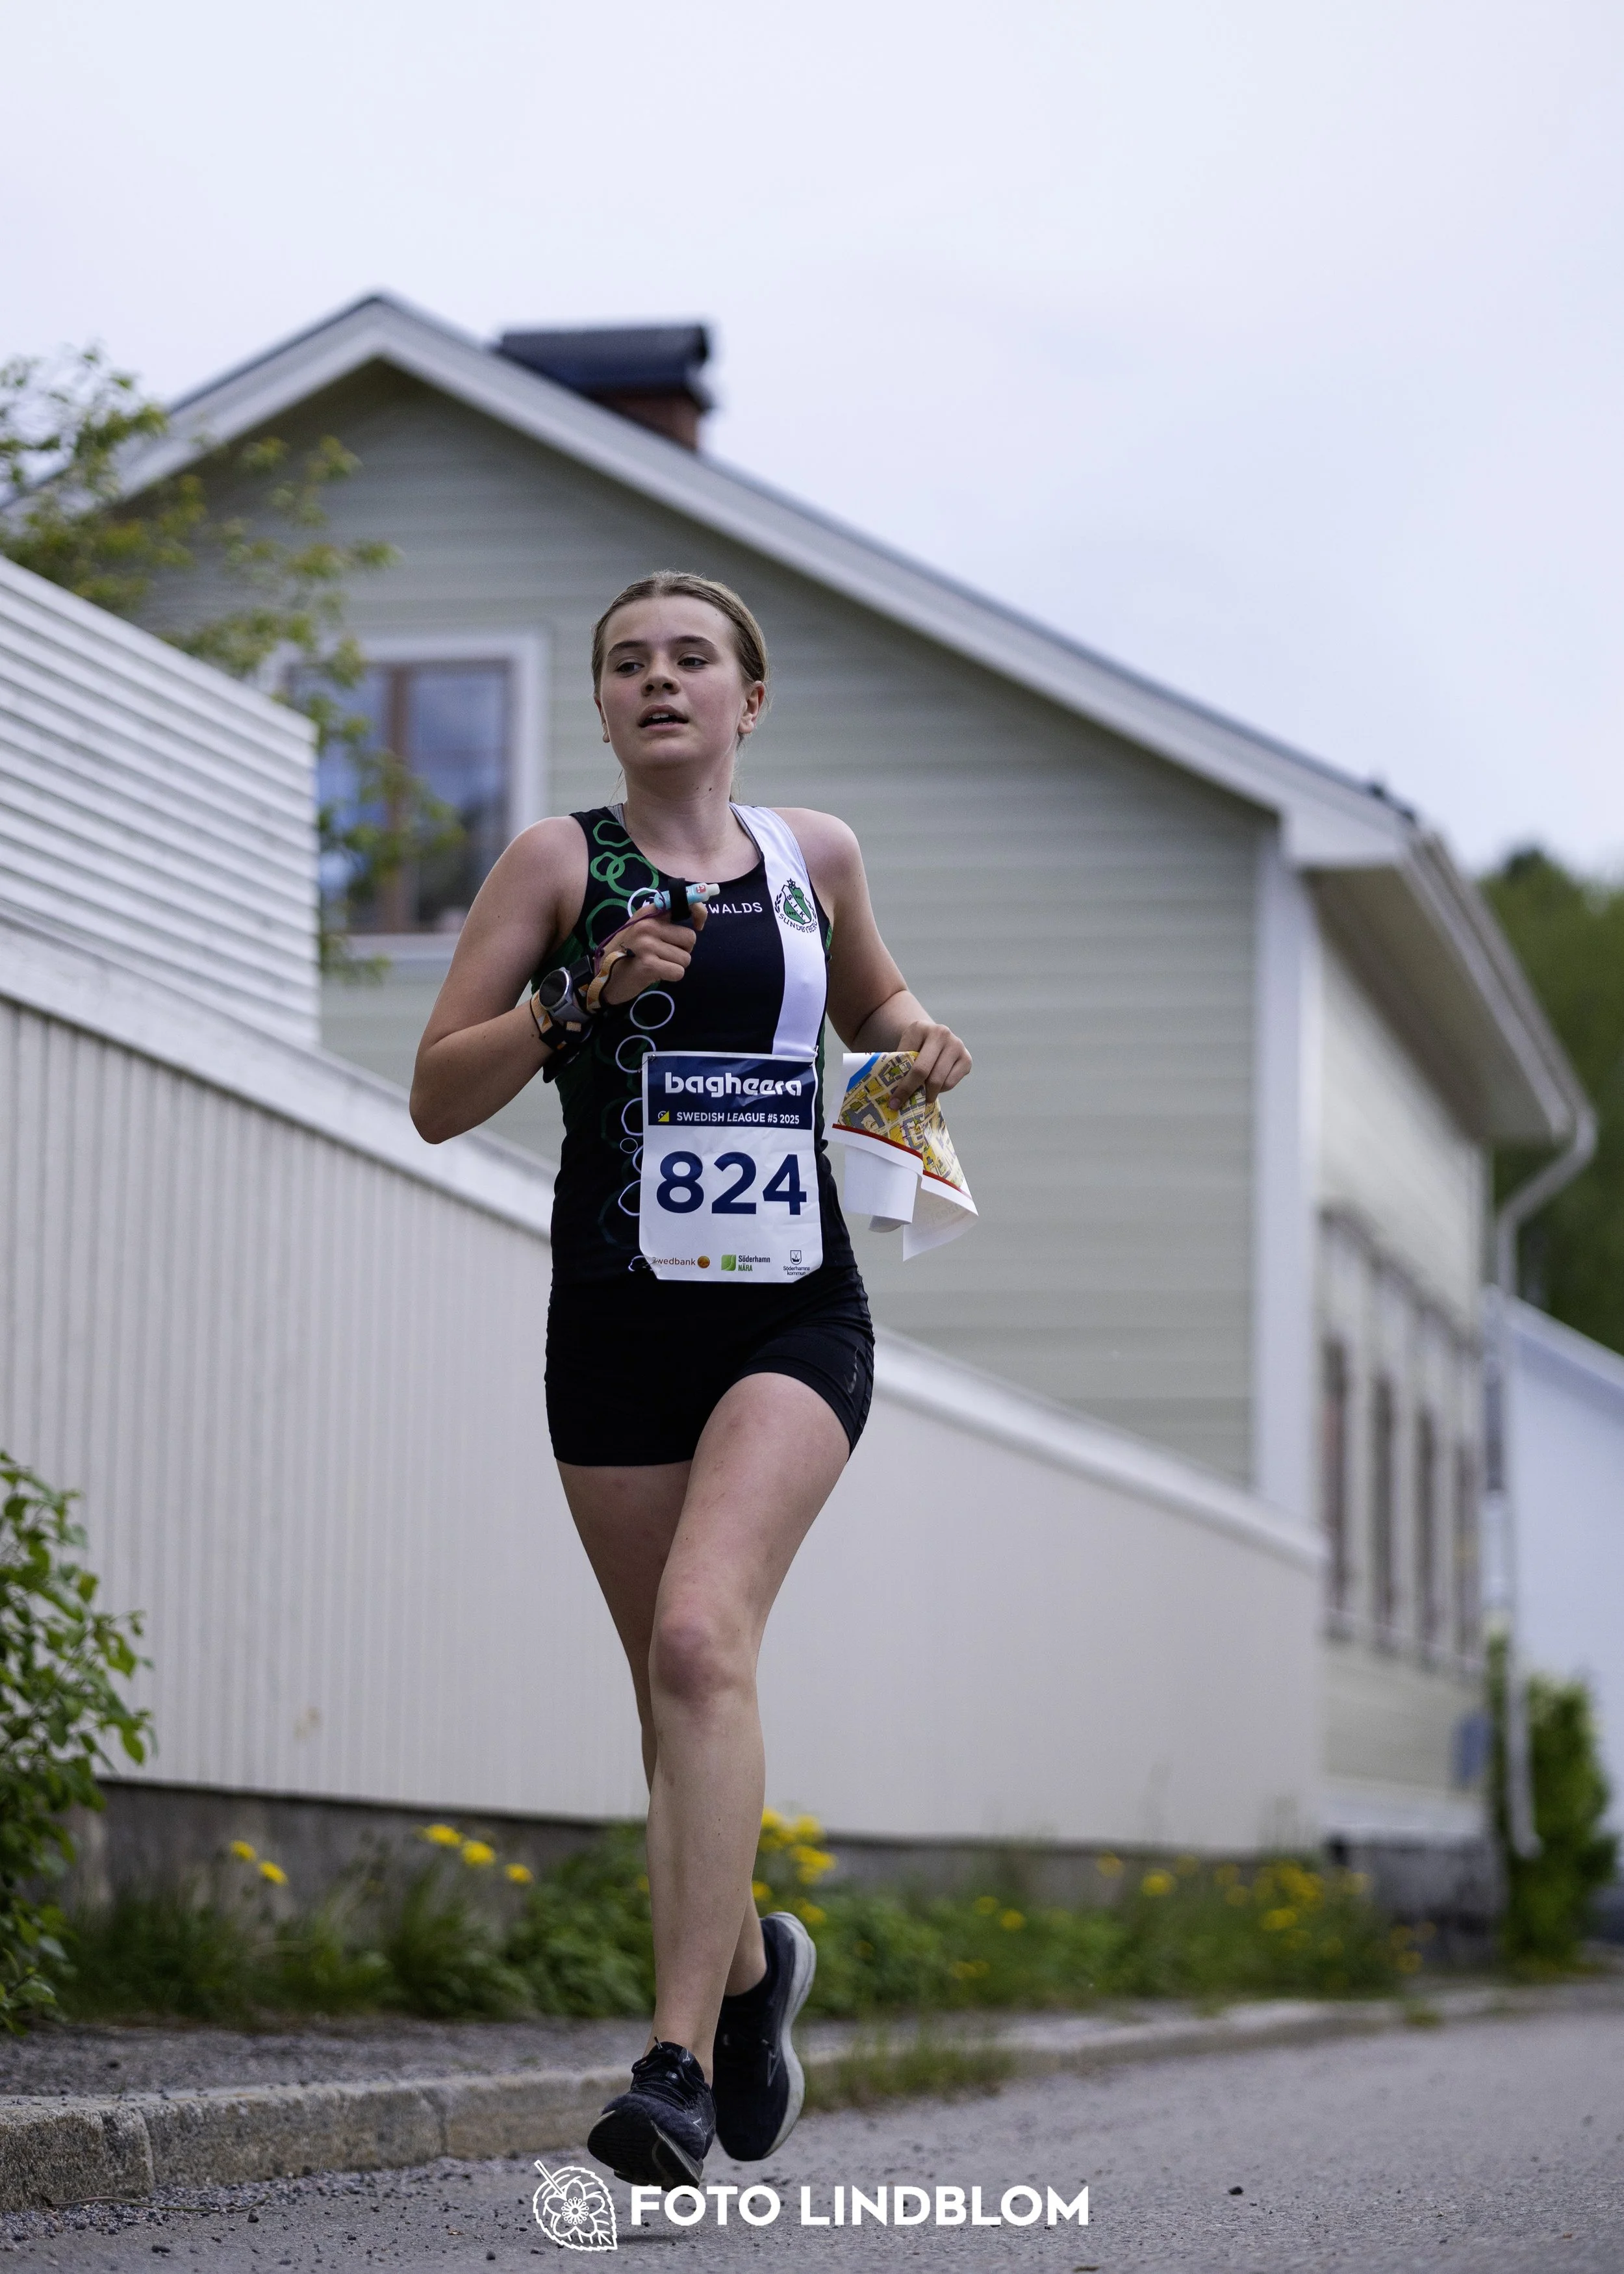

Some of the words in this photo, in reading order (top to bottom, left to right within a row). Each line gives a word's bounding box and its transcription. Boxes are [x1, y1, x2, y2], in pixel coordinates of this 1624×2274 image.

[705, 902, 763, 913] WALDS
[665, 1072, 802, 1097] bagheera
[676, 1112, 724, 1122] SWEDISH
[727, 1112, 765, 1123] LEAGUE
[767, 1113, 778, 1123] #5
[780, 1114, 800, 1125] 2025
[657, 1151, 807, 1216] 824
[738, 1255, 770, 1263] Söderhamn
